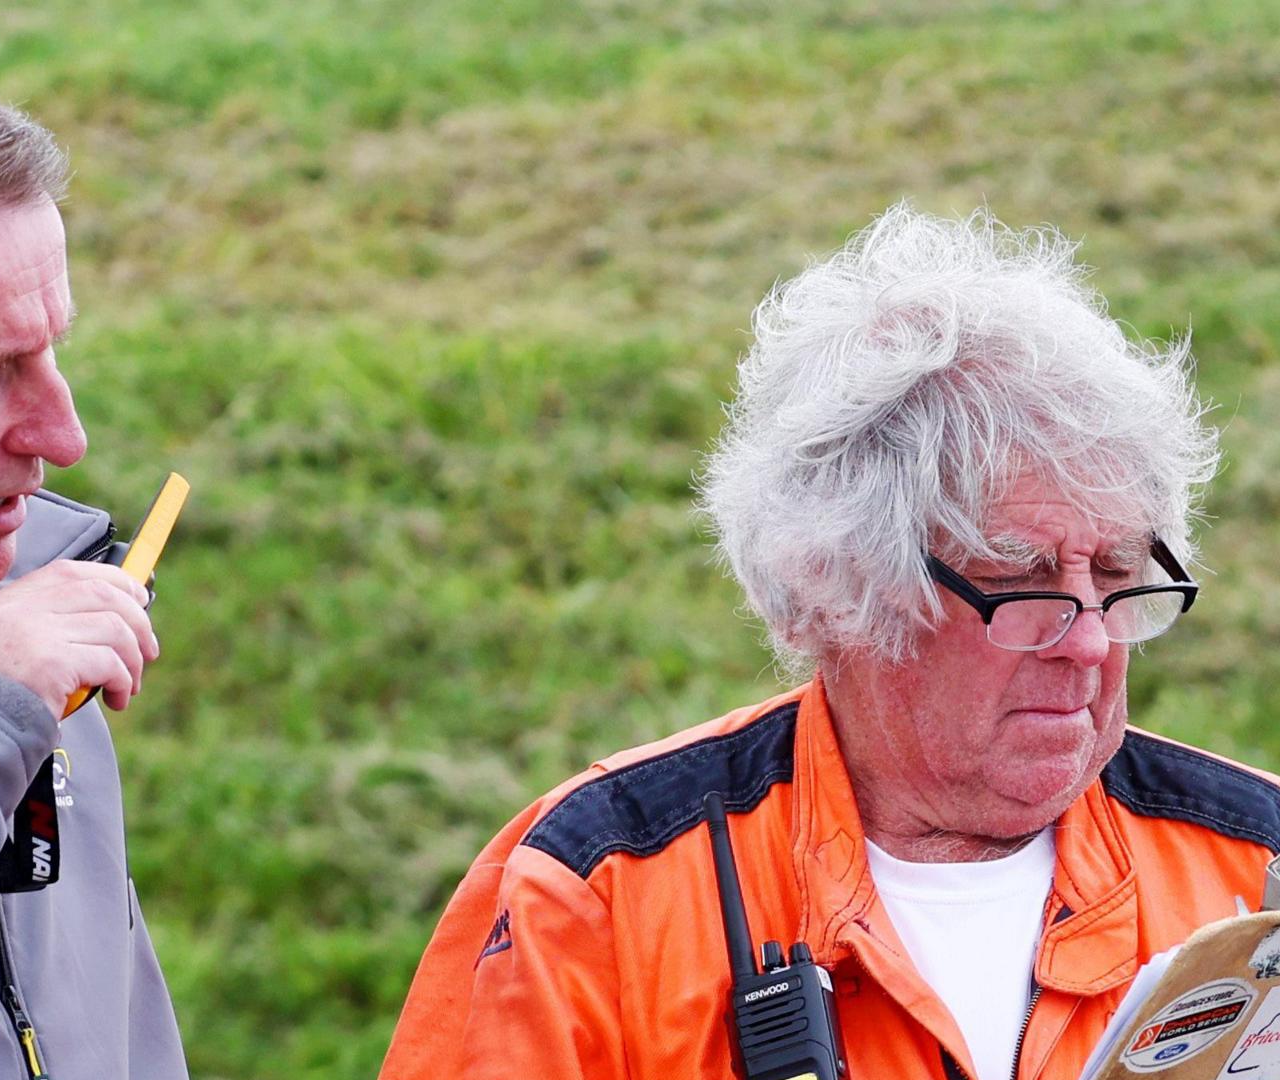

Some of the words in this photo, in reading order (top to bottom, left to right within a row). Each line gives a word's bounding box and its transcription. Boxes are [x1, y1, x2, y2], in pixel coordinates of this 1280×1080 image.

[744, 981, 790, 1004] KENWOOD
[1158, 1024, 1197, 1039] WORLD
[1197, 1013, 1236, 1028] SERIES
